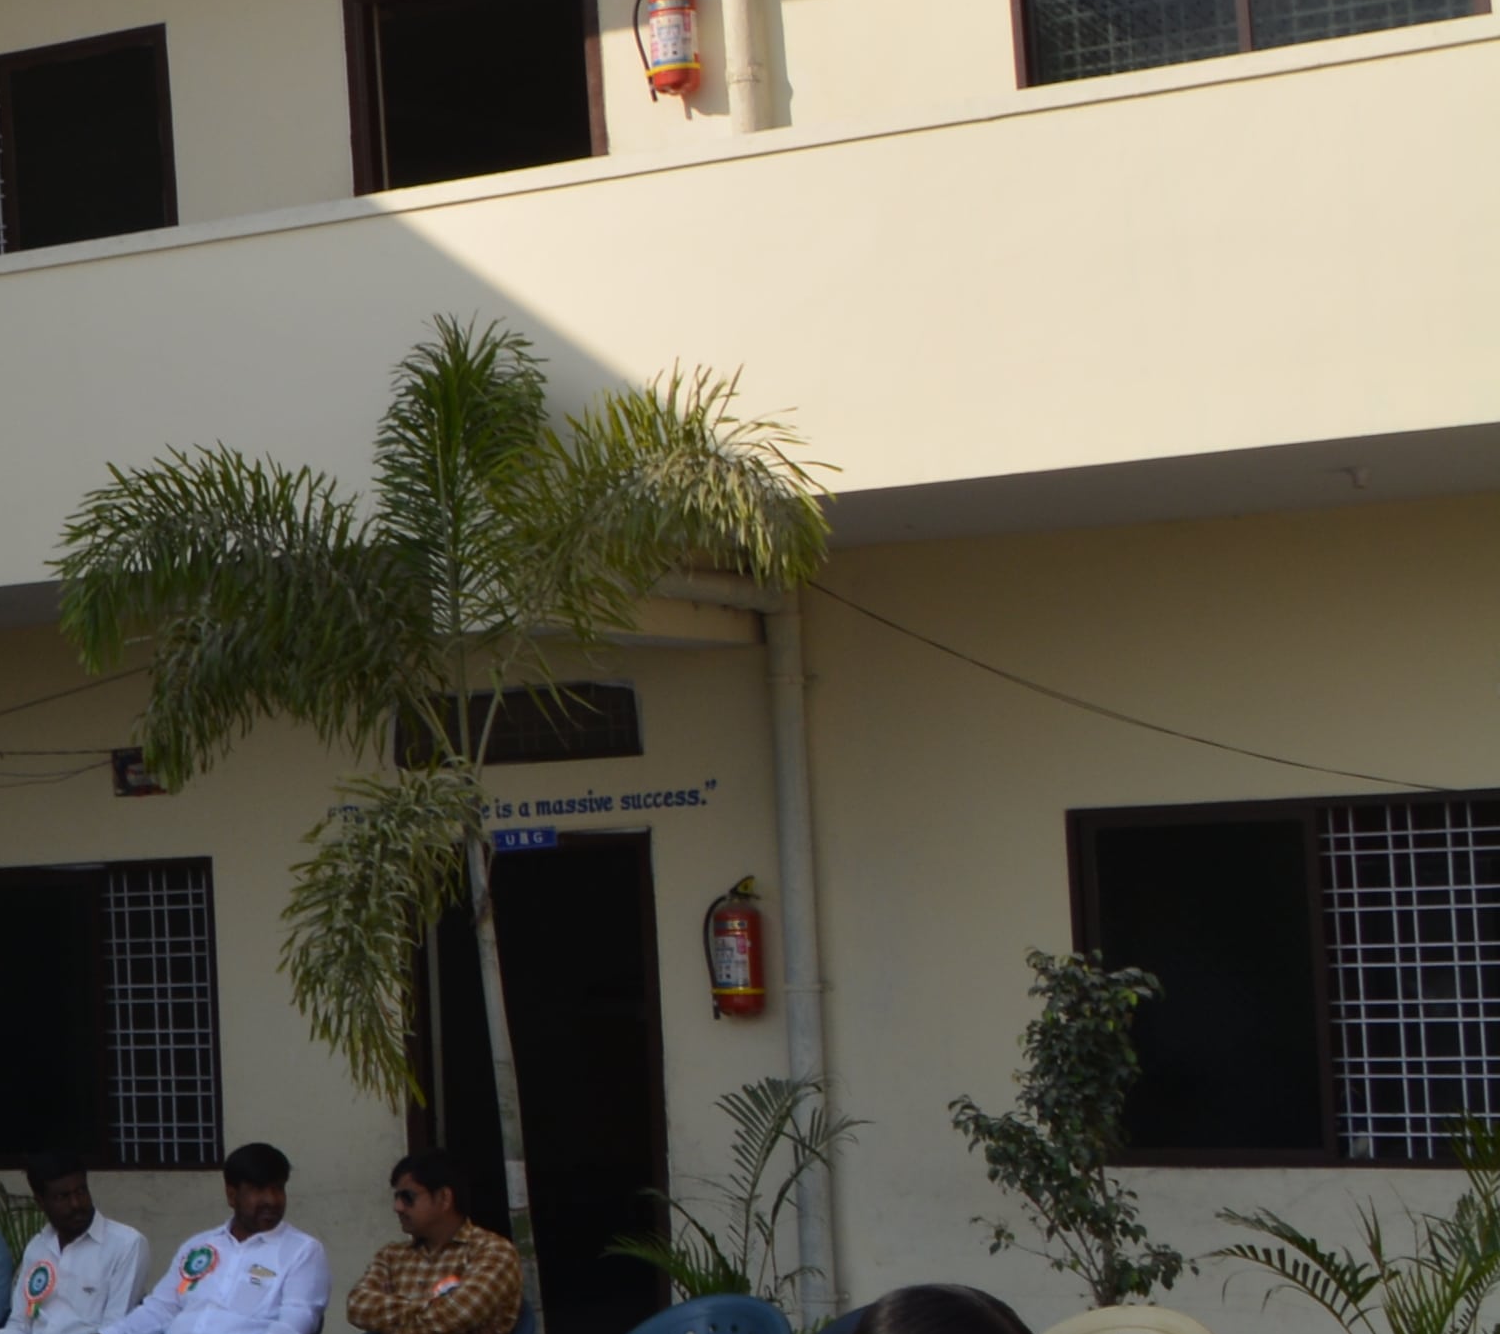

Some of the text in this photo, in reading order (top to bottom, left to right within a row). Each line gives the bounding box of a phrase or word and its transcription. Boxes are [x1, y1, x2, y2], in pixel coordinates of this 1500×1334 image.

[494, 798, 513, 820] is
[518, 802, 531, 817] a
[535, 788, 615, 817] massive
